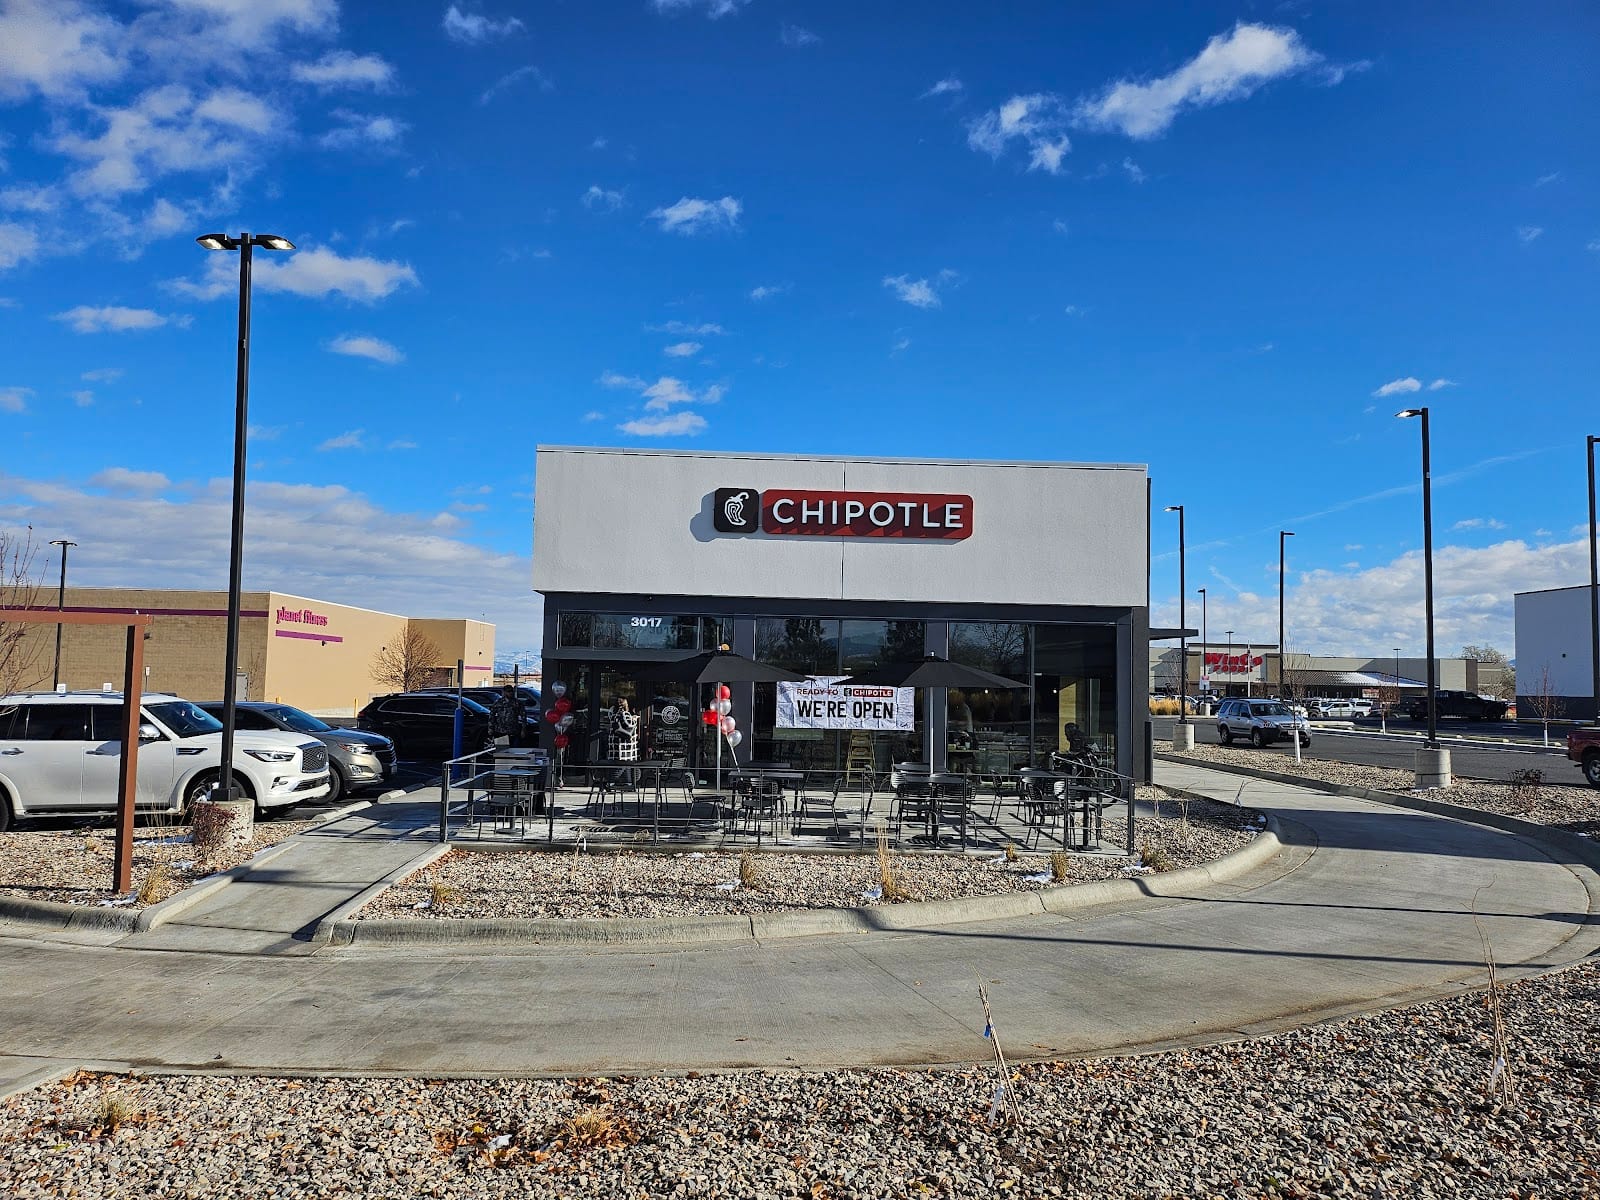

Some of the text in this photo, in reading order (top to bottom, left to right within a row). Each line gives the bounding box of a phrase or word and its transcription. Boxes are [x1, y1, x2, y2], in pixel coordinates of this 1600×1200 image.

[772, 498, 964, 528] CHIPOTLE
[276, 607, 328, 626] planet fitness
[631, 616, 662, 627] 3017
[797, 688, 893, 697] READY TO CHIPOTLE
[797, 700, 893, 719] WE'RE OPEN
